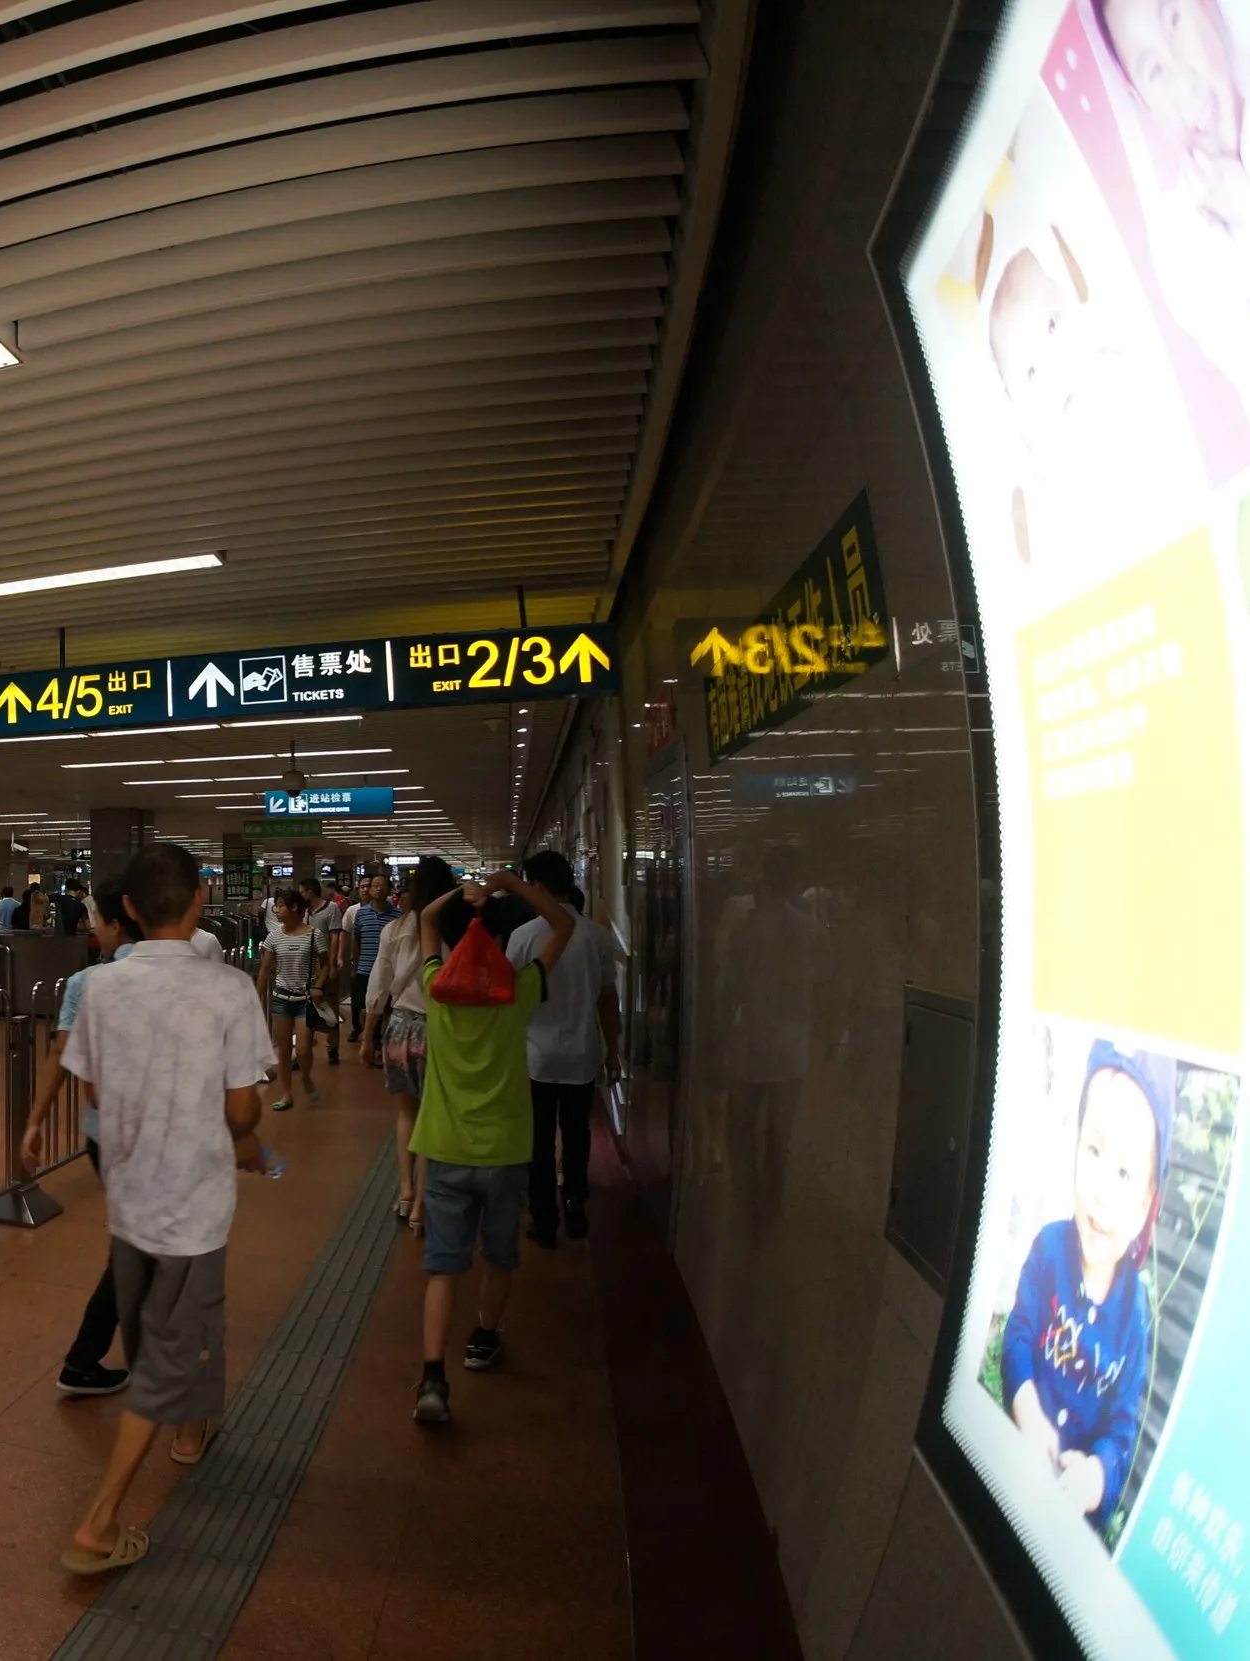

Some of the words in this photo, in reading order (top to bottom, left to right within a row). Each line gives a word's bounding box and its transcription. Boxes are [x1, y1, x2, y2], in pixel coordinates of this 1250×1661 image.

[291, 649, 372, 678] 售票处
[409, 643, 460, 669] 出口
[466, 636, 555, 688] 2/3
[108, 669, 151, 693] 出口
[433, 680, 461, 692] EXIT
[36, 674, 103, 719] 4/5
[292, 688, 344, 702] TICKETS
[108, 704, 133, 716] EXIT
[309, 792, 352, 804] 进站检票
